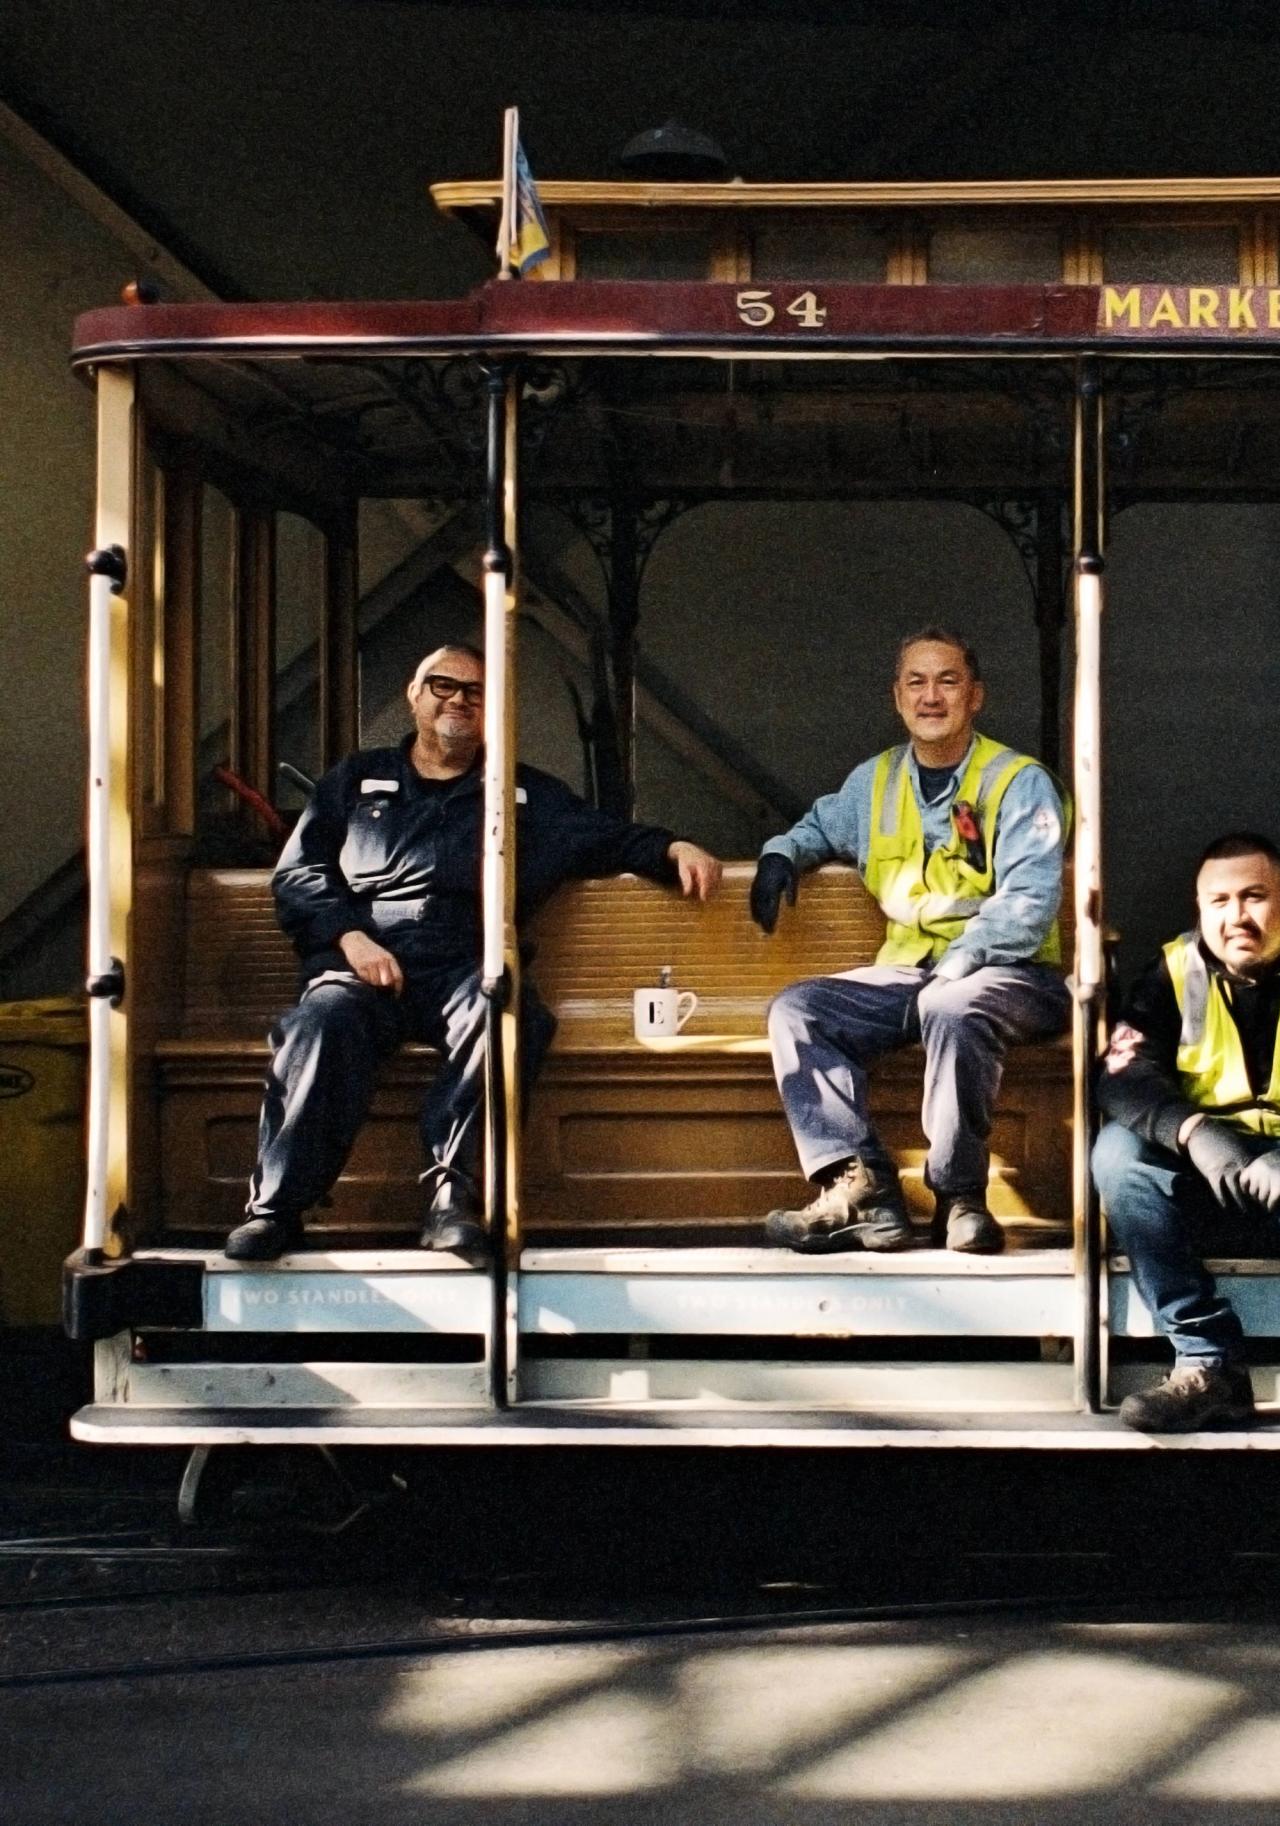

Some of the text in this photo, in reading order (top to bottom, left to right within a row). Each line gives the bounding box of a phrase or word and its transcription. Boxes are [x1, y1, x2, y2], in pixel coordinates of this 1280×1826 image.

[737, 290, 827, 328] 54
[235, 1289, 280, 1305] WO
[287, 1288, 392, 1305] STANDEE
